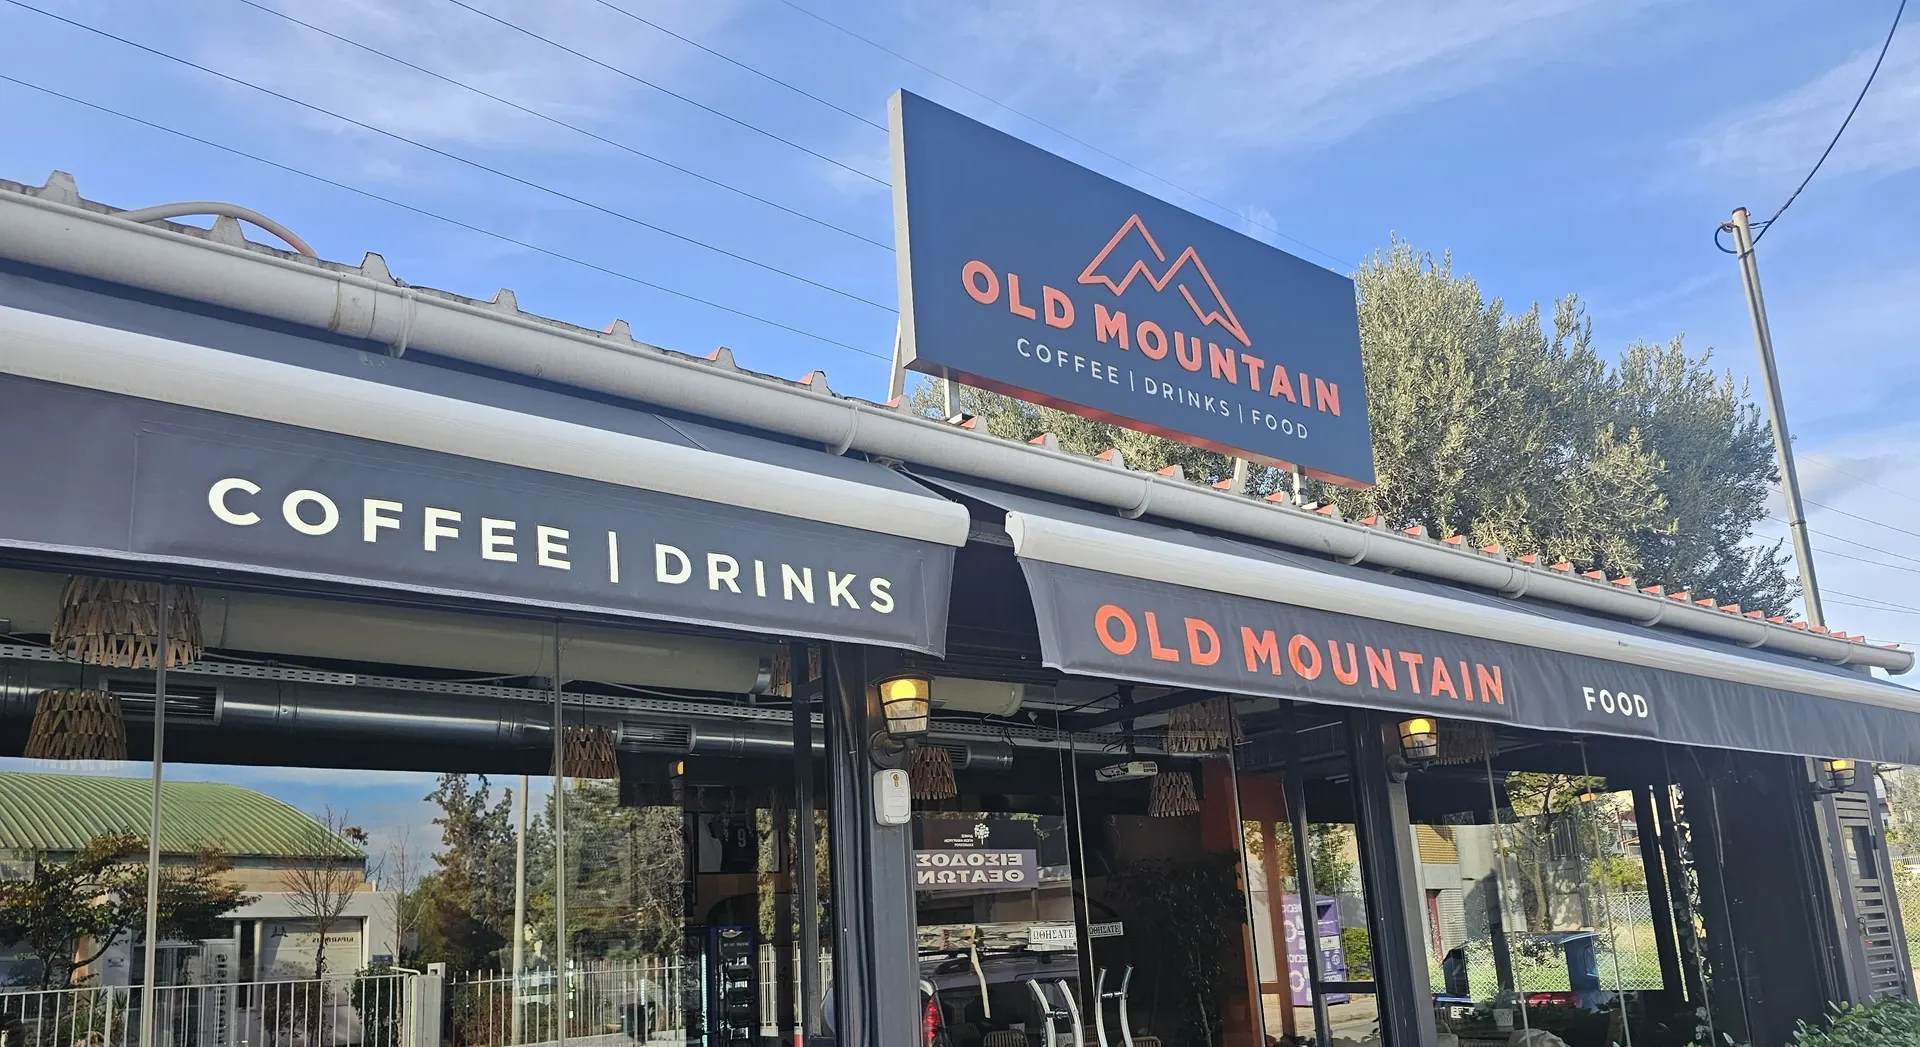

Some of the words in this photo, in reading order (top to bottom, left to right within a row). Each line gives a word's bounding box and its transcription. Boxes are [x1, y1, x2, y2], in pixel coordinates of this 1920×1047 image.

[961, 259, 1075, 330] OLD
[1093, 303, 1342, 417] MOUNTAIN
[1016, 337, 1120, 386] COFFEE
[1144, 376, 1230, 417] DRINKS
[1251, 409, 1310, 440] FOOD
[208, 477, 572, 571] COFFEE
[655, 543, 896, 614] DRINKS
[1095, 604, 1221, 666] OLD
[1240, 625, 1505, 706] MOUNTAIN
[1582, 686, 1649, 719] FOOD
[1033, 929, 1075, 940] ΩΘΗΣΑΤΕ
[1088, 925, 1120, 935] ΩΘΗΣΑΤΕ
